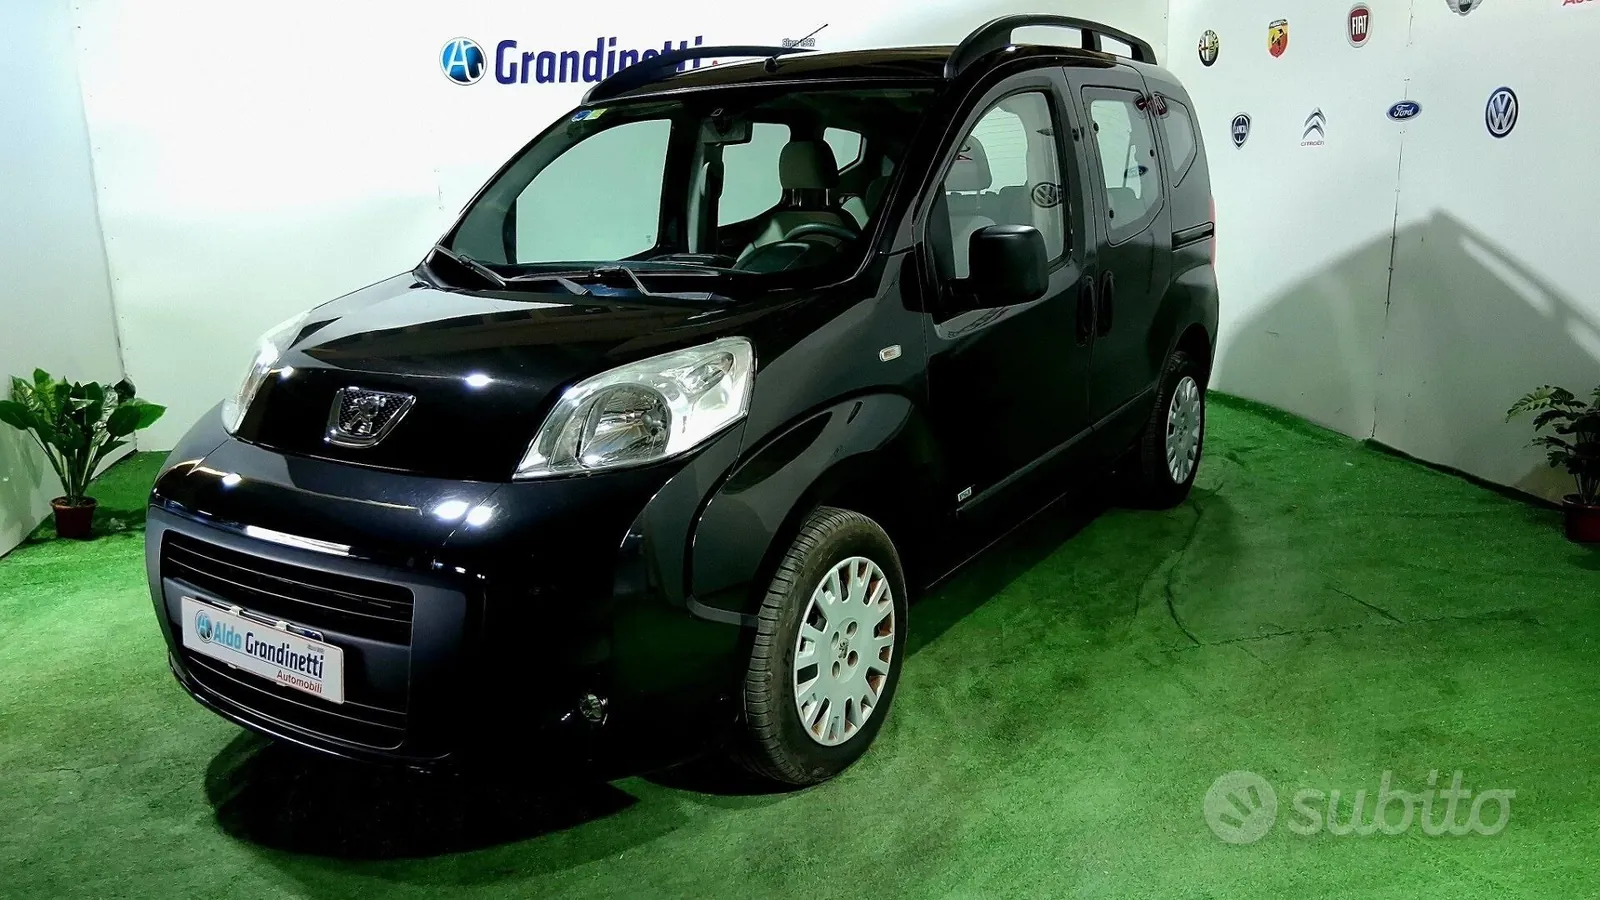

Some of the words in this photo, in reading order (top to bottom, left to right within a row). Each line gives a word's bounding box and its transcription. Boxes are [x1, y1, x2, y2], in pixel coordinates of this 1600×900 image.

[1351, 15, 1368, 36] FIAT
[1393, 104, 1415, 118] Ford
[213, 619, 242, 650] Aldo
[245, 631, 324, 679] Grandinetti
[277, 669, 323, 694] Automobili
